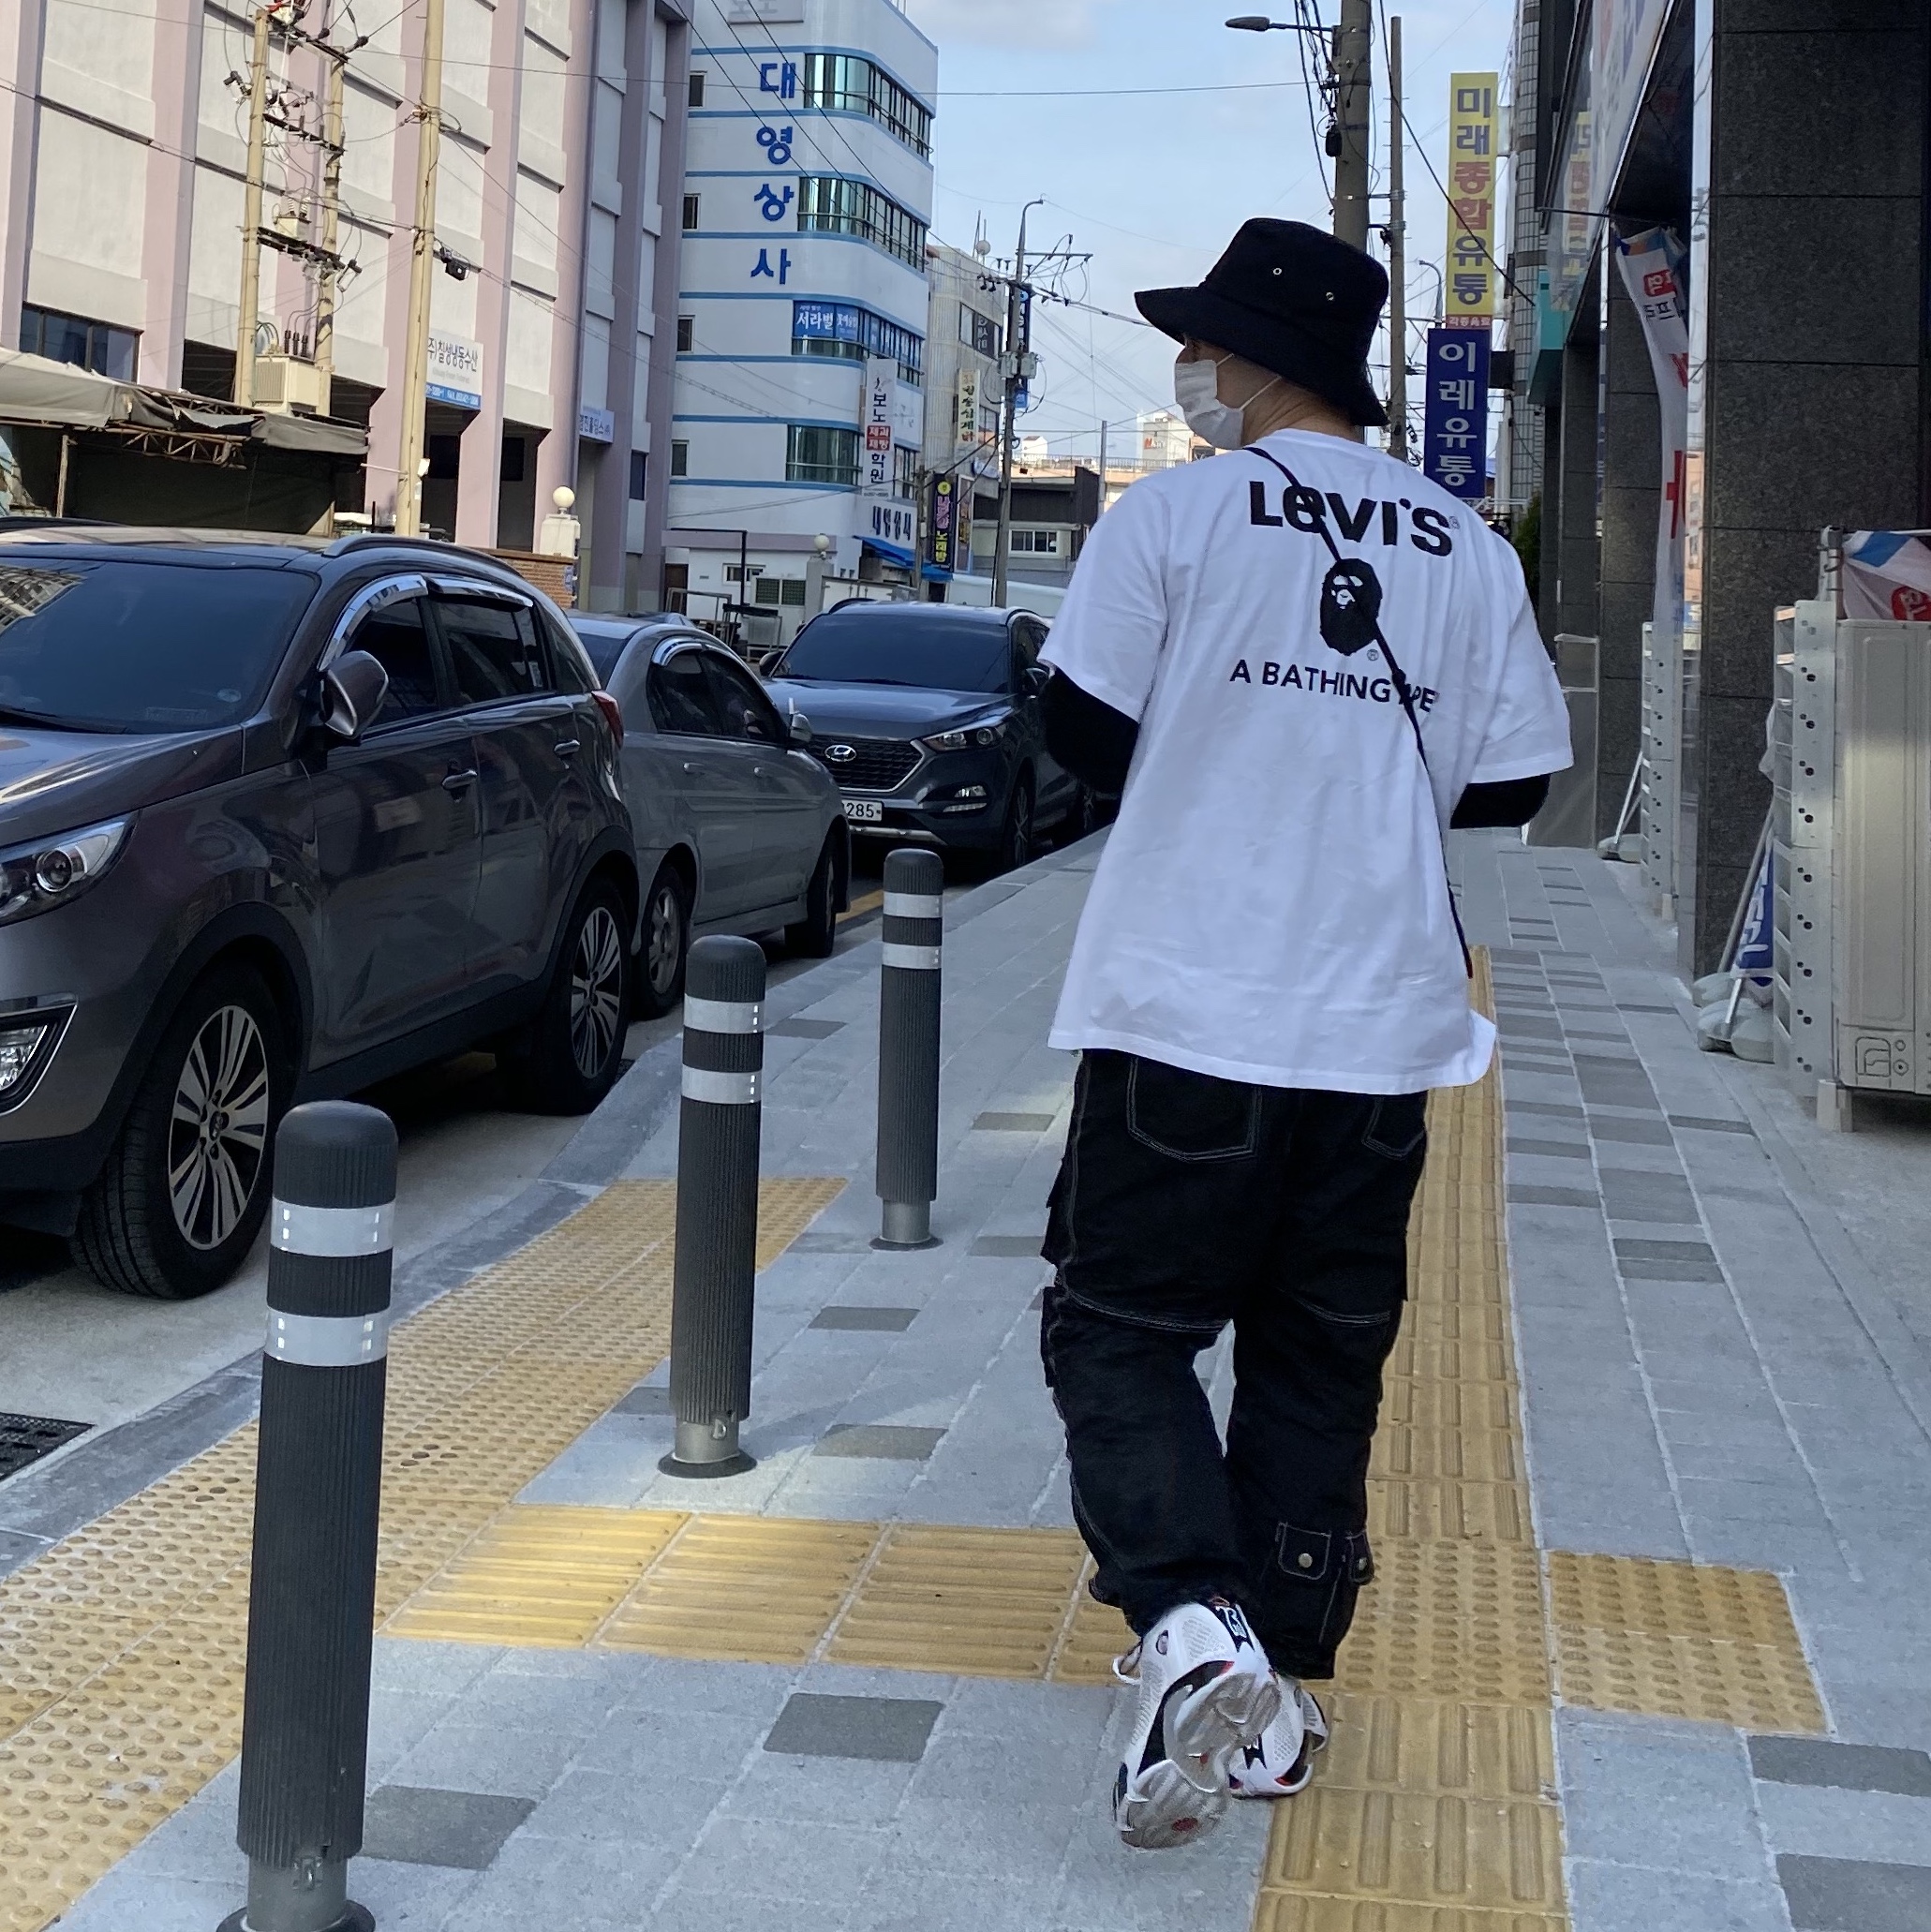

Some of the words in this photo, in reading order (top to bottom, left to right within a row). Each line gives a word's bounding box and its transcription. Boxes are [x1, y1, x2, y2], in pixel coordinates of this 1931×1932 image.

[750, 62, 796, 285] 대영상사
[1452, 88, 1492, 305] 미래종합유통
[795, 312, 834, 331] 서라벌
[427, 337, 479, 373] 주)칠성냉동수산
[872, 394, 886, 423] 보노
[1434, 341, 1478, 487] 이레유통
[870, 453, 885, 484] 학원
[1229, 659, 1252, 684] A
[1262, 661, 1391, 703] BATHING
[845, 802, 874, 818] 285
